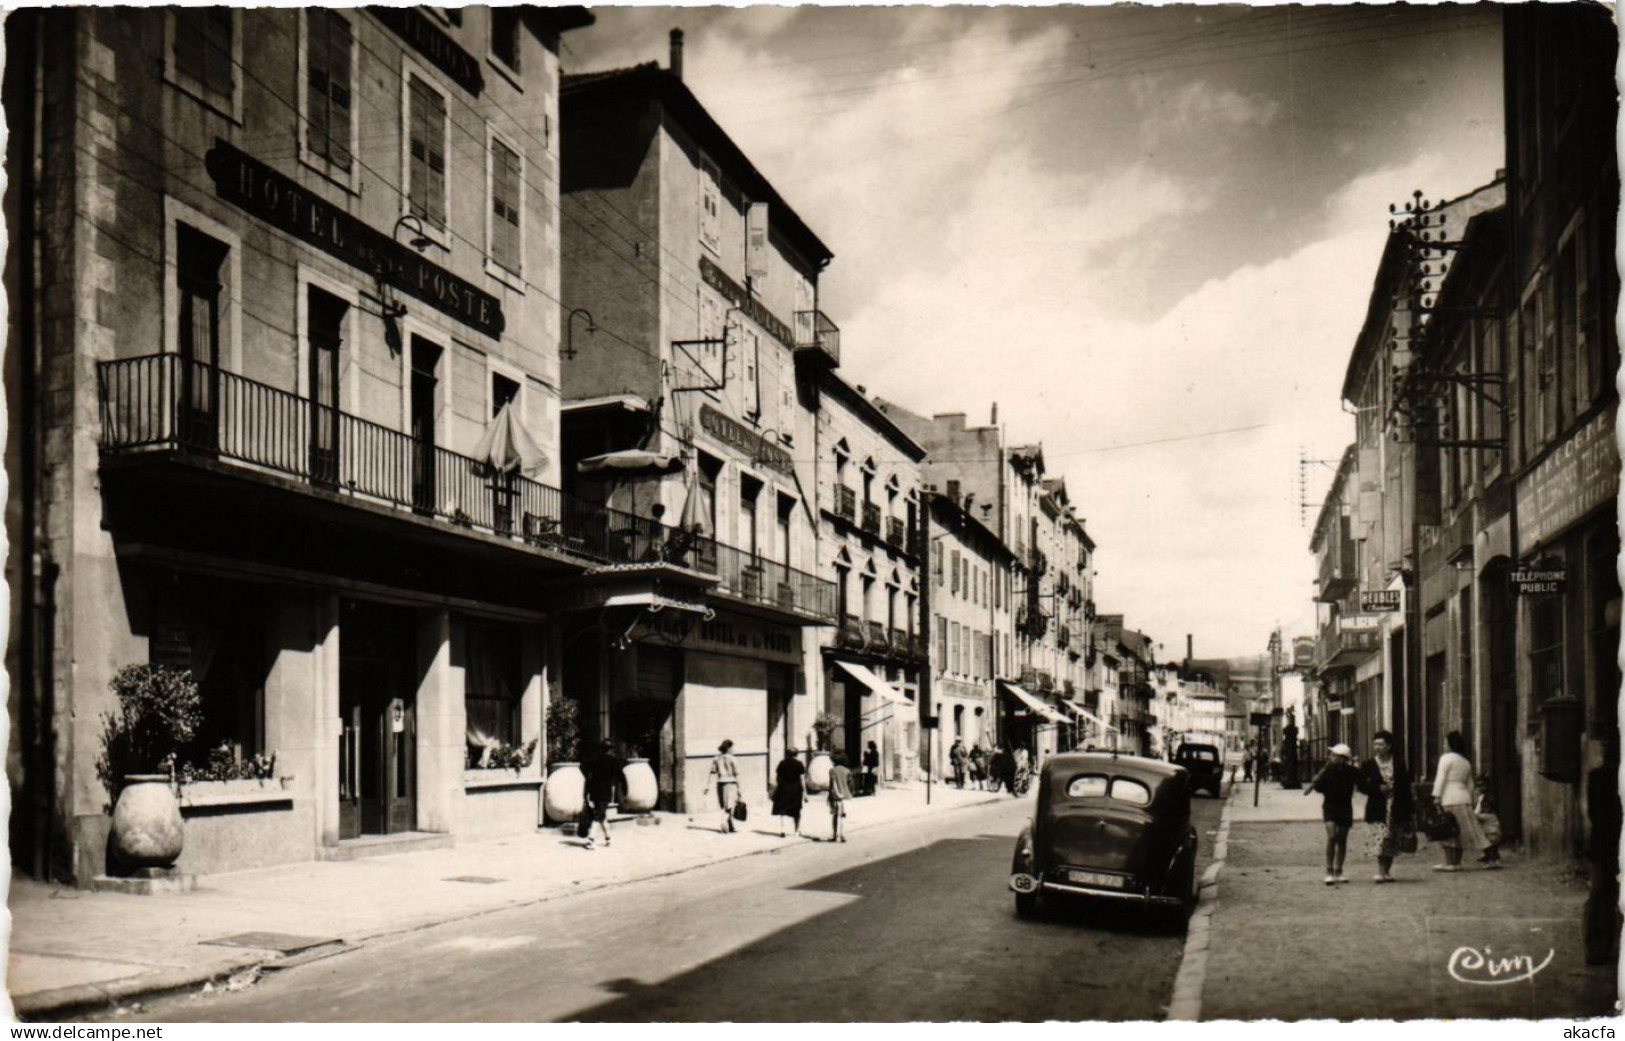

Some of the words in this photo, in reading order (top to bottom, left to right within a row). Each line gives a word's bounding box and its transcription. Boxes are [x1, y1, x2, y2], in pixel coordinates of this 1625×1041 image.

[418, 262, 491, 326] POSTE
[1519, 581, 1558, 593] PUBLIC
[1361, 590, 1400, 604] MEUBLES
[1014, 876, 1032, 890] GB
